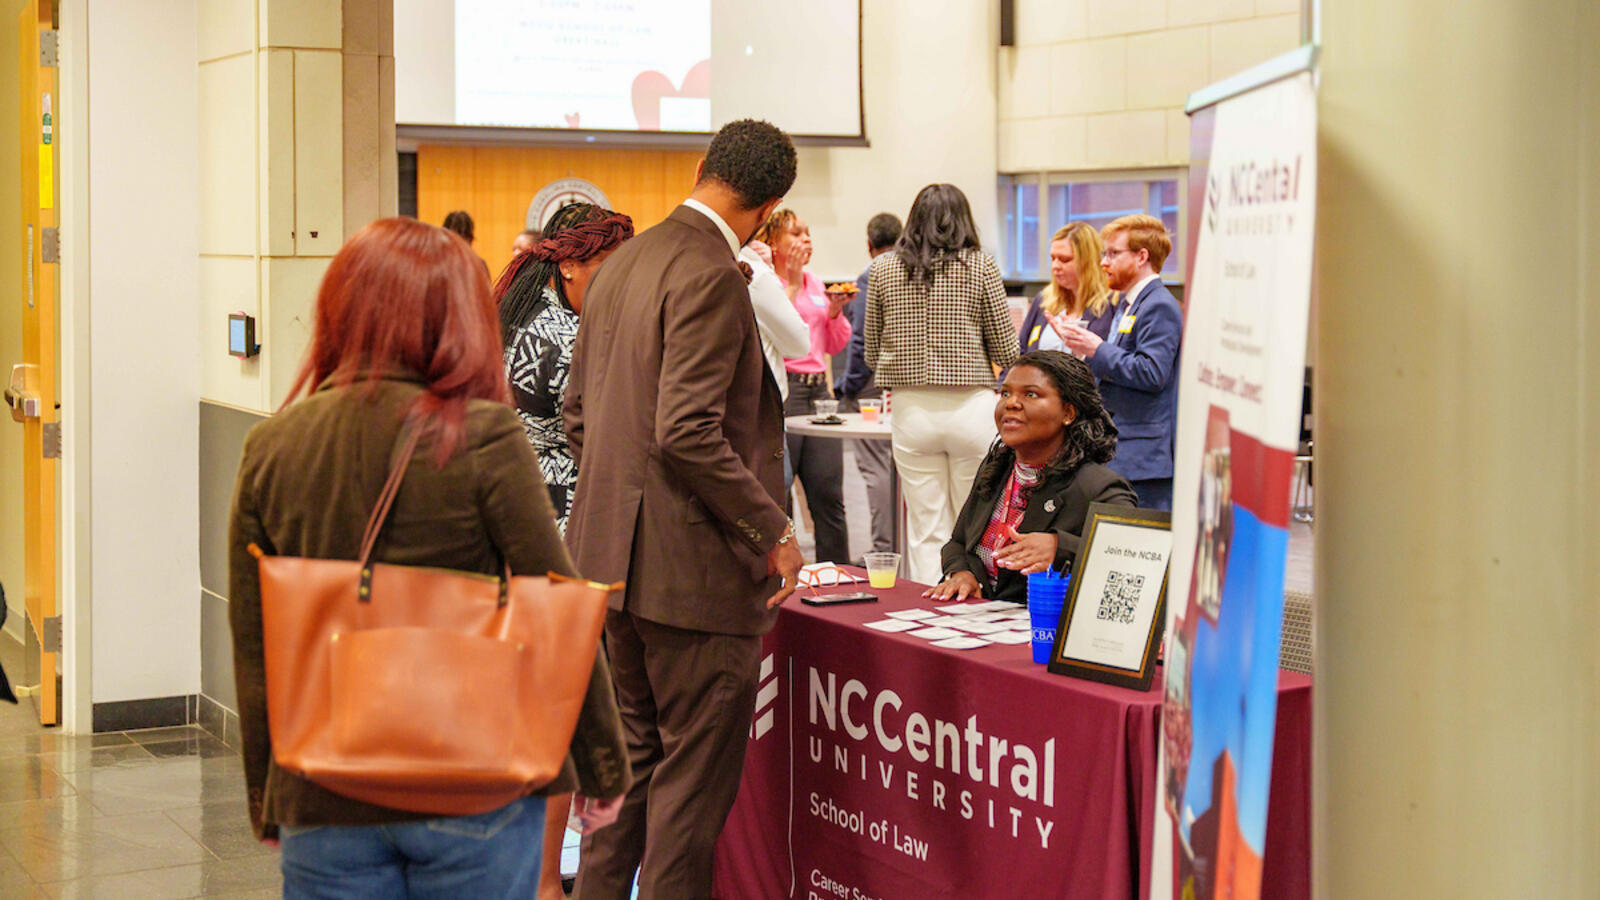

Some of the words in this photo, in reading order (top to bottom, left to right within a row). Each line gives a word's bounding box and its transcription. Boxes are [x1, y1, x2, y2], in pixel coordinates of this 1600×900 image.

[1104, 545, 1122, 556] Join
[1123, 548, 1137, 559] the
[1138, 550, 1162, 561] NCBA
[808, 666, 1056, 808] NCCentral
[809, 735, 1055, 850] UNIVERSITY
[810, 792, 865, 836] School
[869, 819, 889, 845] of
[893, 824, 929, 862] Law
[810, 868, 851, 900] Career
